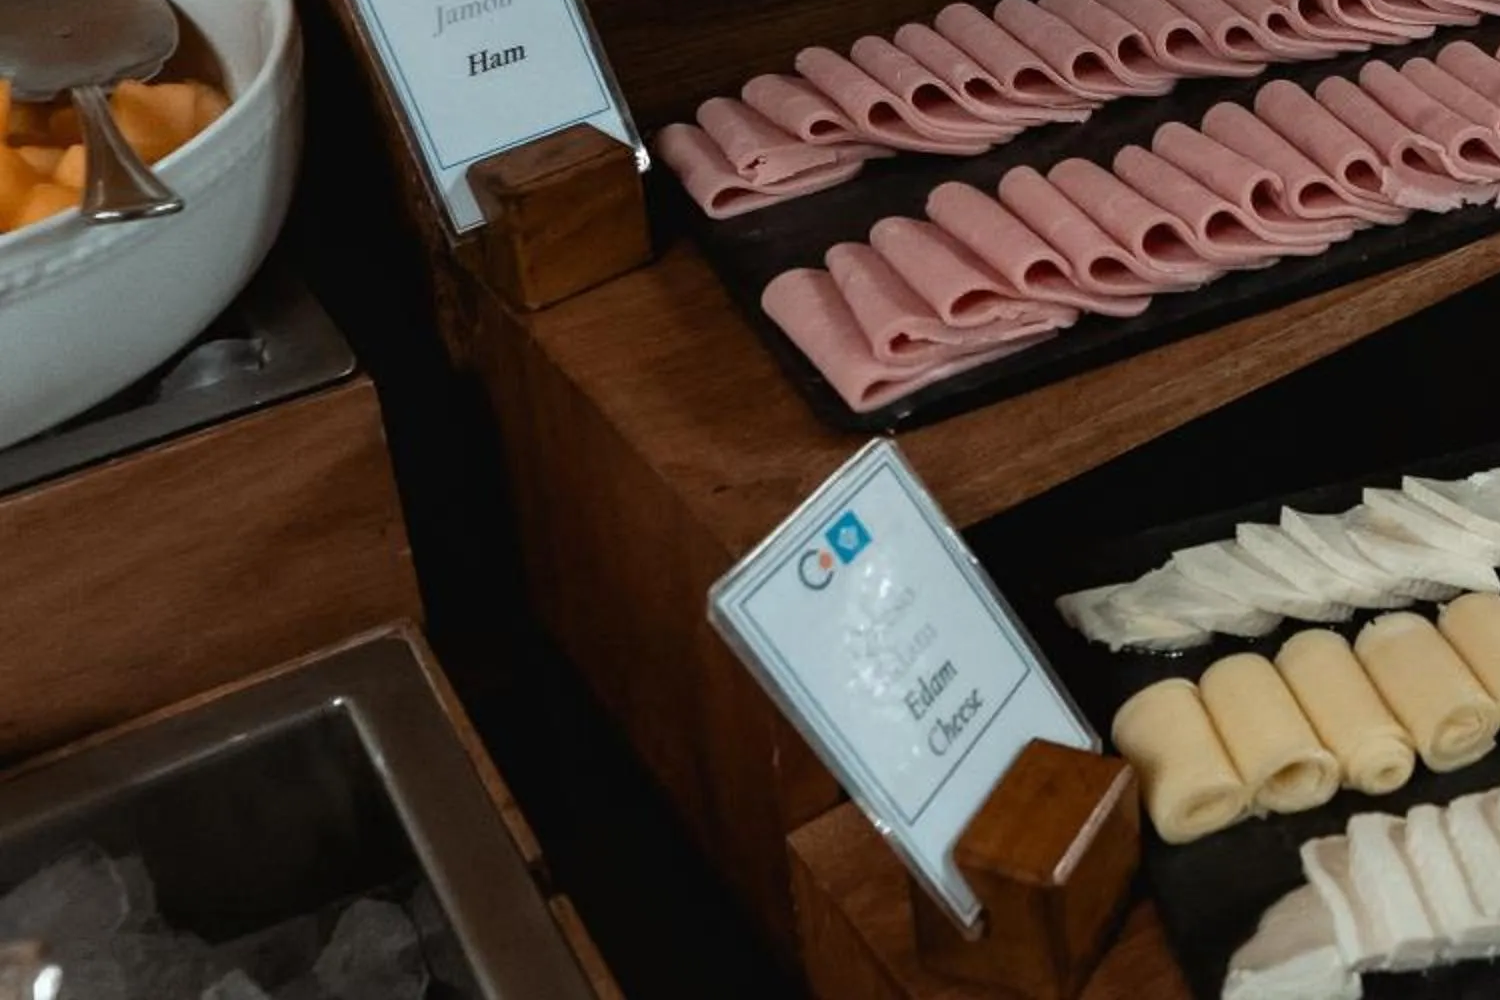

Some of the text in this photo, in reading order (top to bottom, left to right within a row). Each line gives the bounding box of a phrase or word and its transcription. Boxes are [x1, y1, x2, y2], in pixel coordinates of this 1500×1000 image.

[468, 45, 527, 76] Ham
[903, 660, 958, 721] Edam
[927, 688, 983, 757] Cheese
